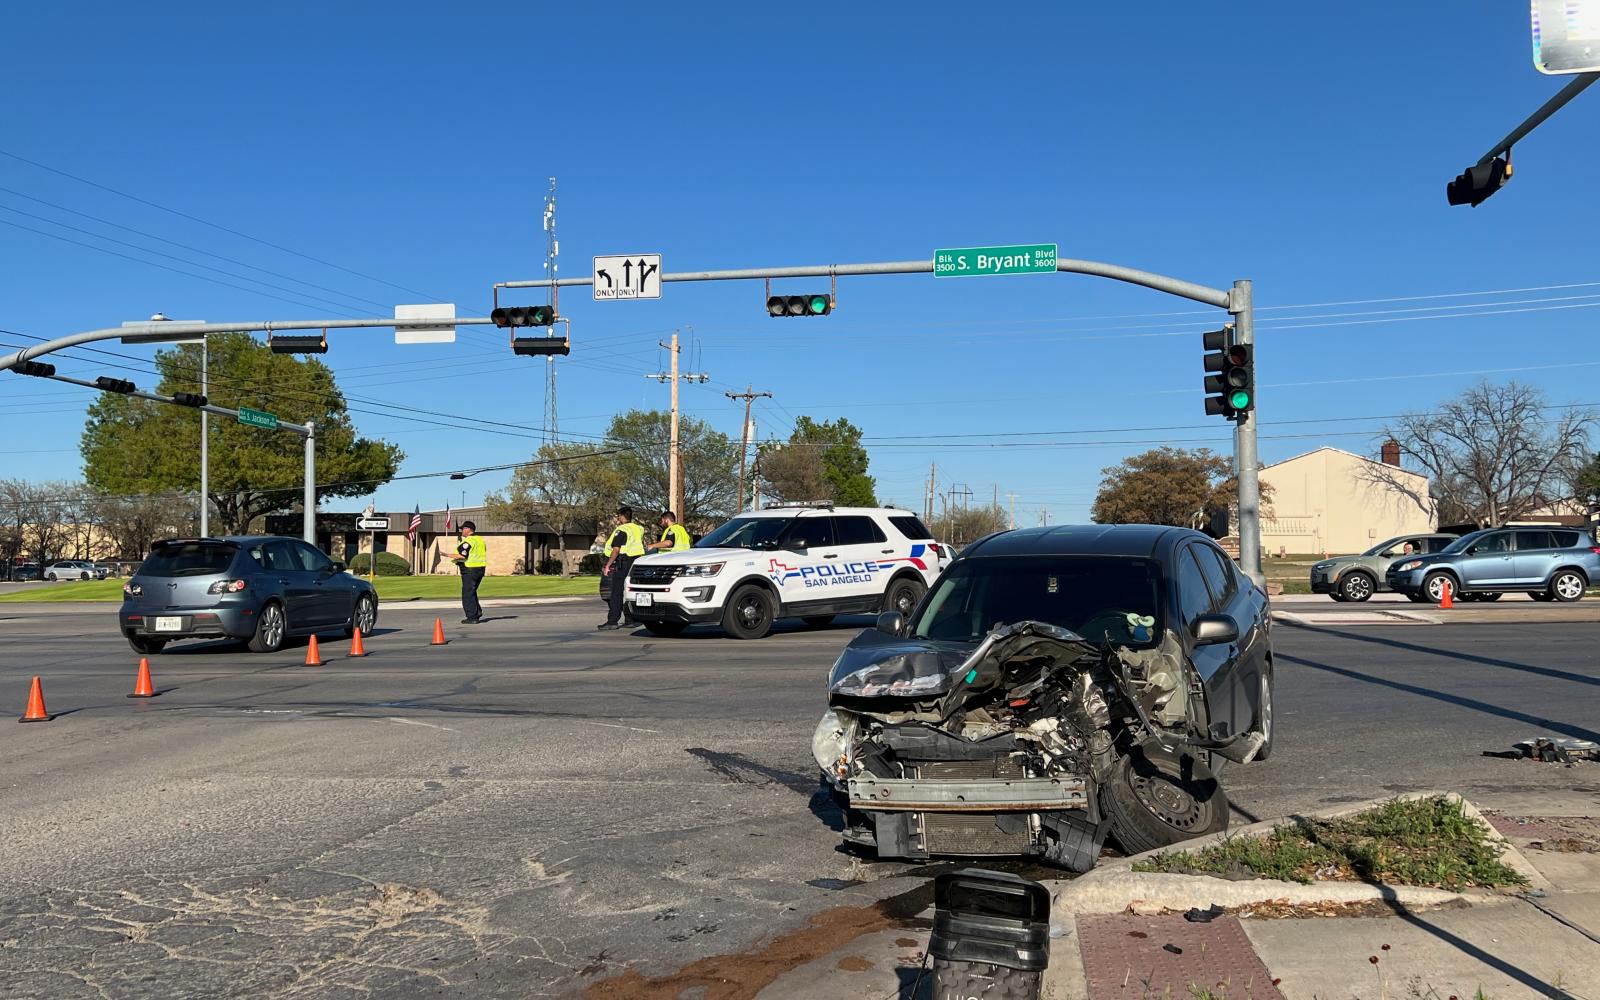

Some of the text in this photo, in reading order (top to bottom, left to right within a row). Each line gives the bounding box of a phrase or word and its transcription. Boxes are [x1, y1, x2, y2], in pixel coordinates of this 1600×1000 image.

[1035, 249, 1054, 259] Blvd
[938, 255, 953, 263] Blk
[957, 252, 1031, 272] S. Bryant
[1034, 259, 1055, 268] 3600
[936, 264, 956, 272] 3500
[596, 288, 636, 297] ONLY ONLY
[800, 561, 879, 578] POLICE
[805, 574, 872, 588] SAN ANGELO
